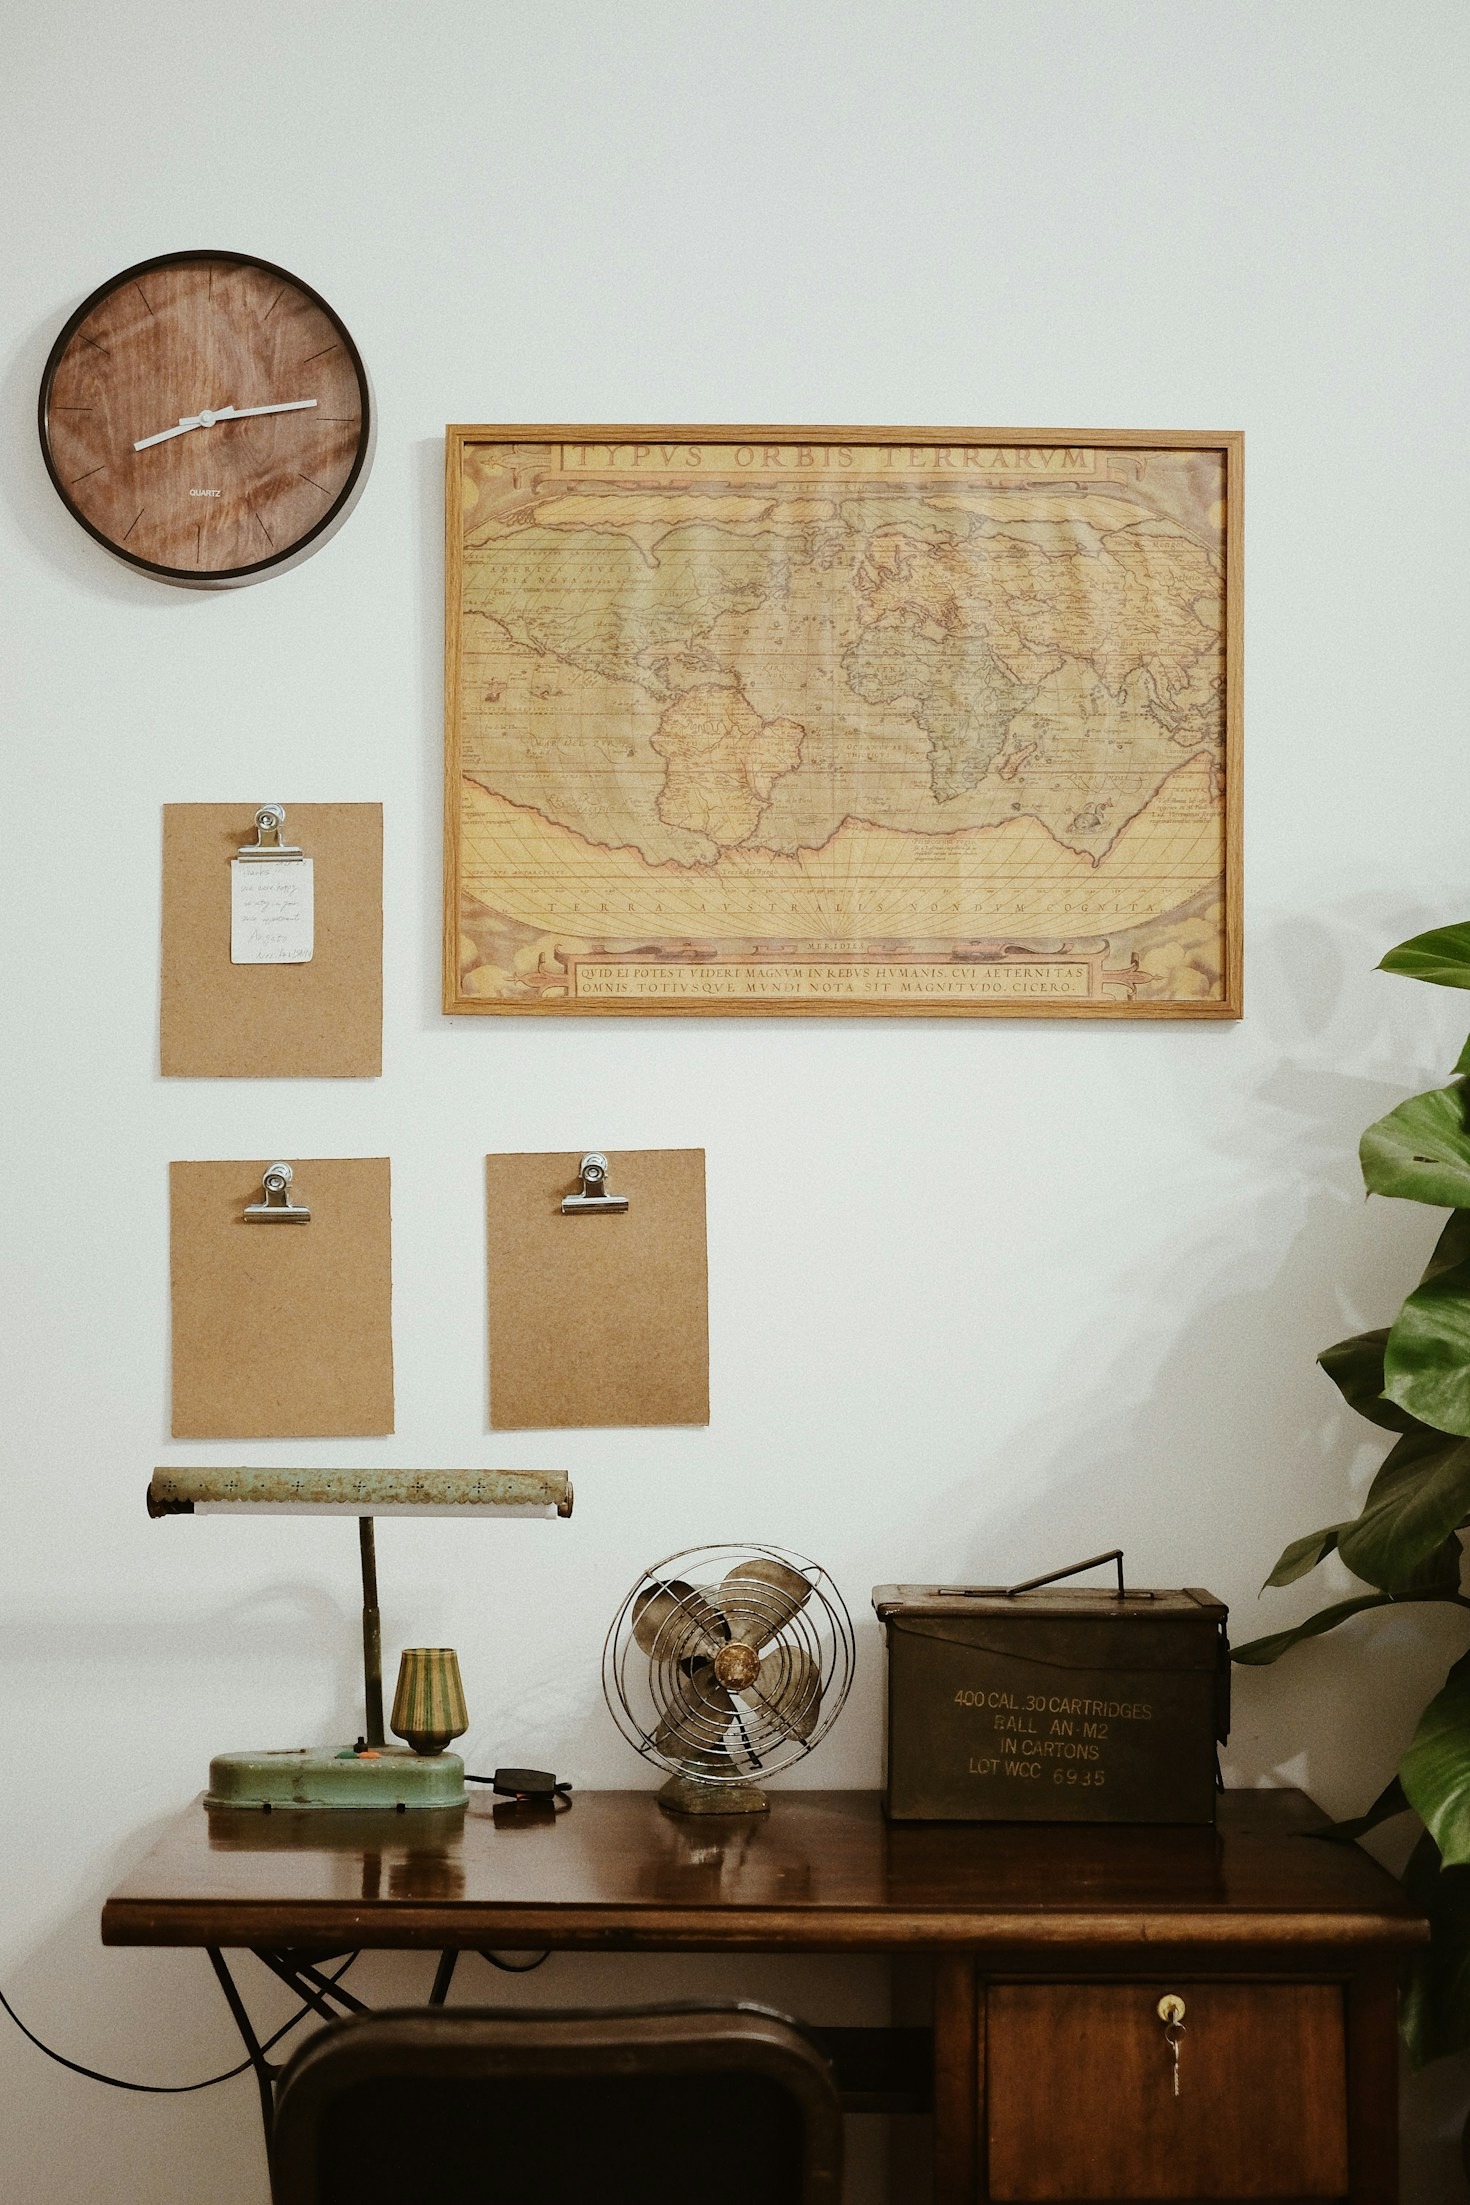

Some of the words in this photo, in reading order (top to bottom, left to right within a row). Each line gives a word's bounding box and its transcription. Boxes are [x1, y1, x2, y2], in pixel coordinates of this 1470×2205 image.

[572, 445, 702, 467] TYPVS
[734, 446, 854, 467] ORBIS
[879, 447, 1088, 469] TERRARVM
[189, 489, 221, 498] QUARTZ
[546, 903, 663, 912] TERRA
[581, 968, 613, 980] QVID
[616, 968, 630, 979] EI
[633, 968, 685, 979] POTEST
[689, 968, 740, 978] VIDERI
[745, 968, 803, 978] MAGNVM
[808, 968, 823, 978] IN
[826, 968, 870, 978] REBVS
[952, 968, 976, 978] CVI
[984, 968, 1084, 978] AETERNITAS
[637, 982, 735, 994] TOTIVSQVE
[746, 982, 801, 993] MVNDI
[810, 982, 854, 993] NOTA
[864, 982, 891, 992] SIT
[953, 1690, 985, 1707] 400
[1048, 1697, 1152, 1720] CARTRIDGES
[993, 1714, 1037, 1733] BALL
[1000, 1737, 1016, 1754] IN
[1022, 1739, 1100, 1760] CARTONS
[968, 1757, 1000, 1774] LOT
[1005, 1761, 1042, 1778] WCC
[1053, 1768, 1106, 1786] 6935
